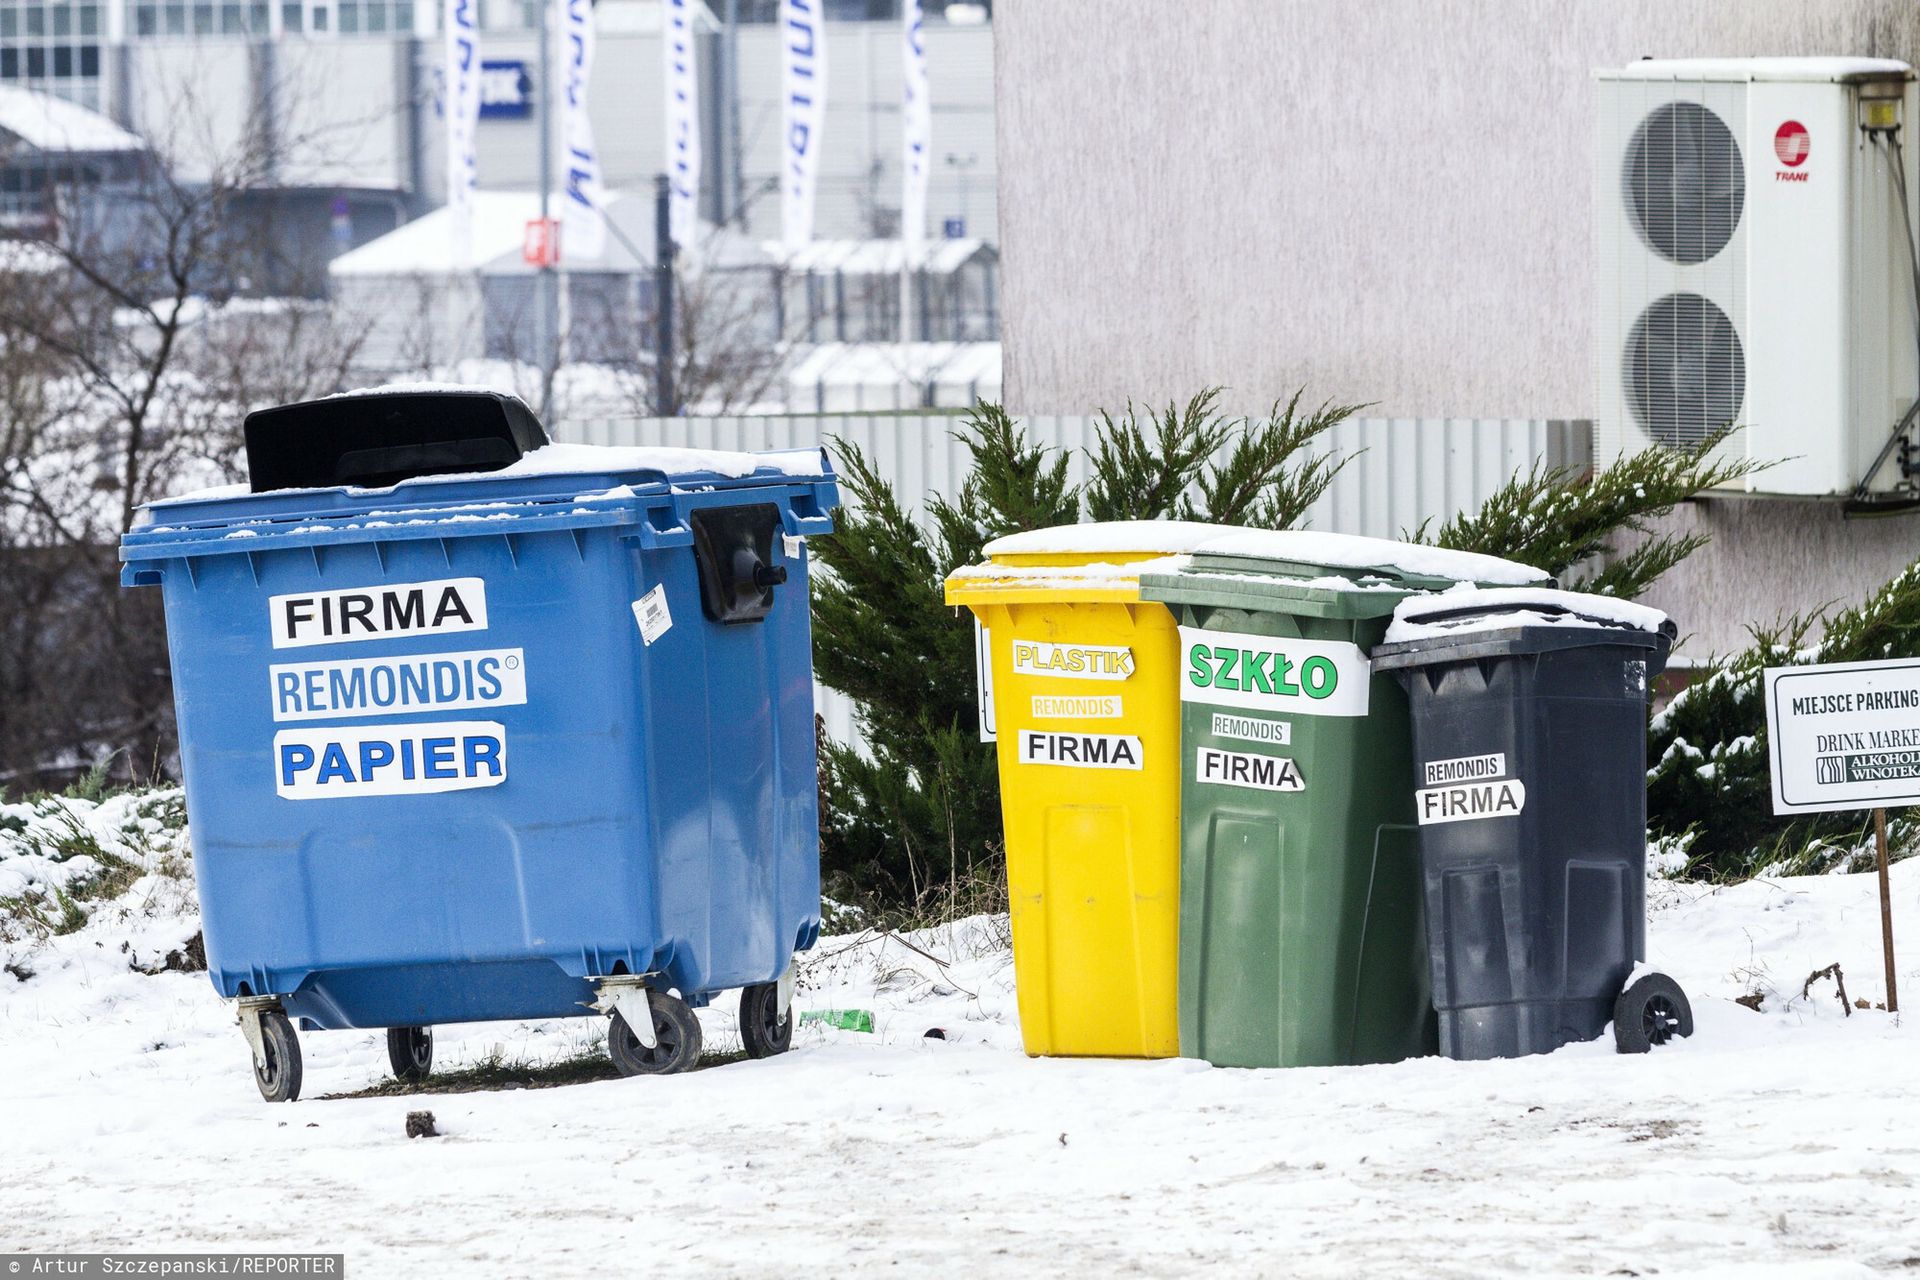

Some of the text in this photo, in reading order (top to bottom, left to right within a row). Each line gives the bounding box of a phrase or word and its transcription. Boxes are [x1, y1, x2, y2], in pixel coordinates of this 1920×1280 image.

[1776, 172, 1809, 181] TRANE
[285, 586, 474, 639] FIRMA
[1016, 645, 1131, 674] PLASTIK
[1189, 643, 1338, 699] SZKŁO
[1034, 698, 1114, 715] REMONDIS
[1792, 689, 1919, 716] MIEJSCE PARKING
[1214, 716, 1283, 741] REMONDIS
[1029, 733, 1136, 765] FIRMA
[1816, 732, 1866, 753] DRINK
[281, 735, 503, 786] PAPIER
[1205, 752, 1298, 788] FIRMA
[1427, 757, 1498, 783] REMONDIS
[1851, 752, 1920, 768] ALKOHOL
[1851, 765, 1920, 780] WINOTEK
[1424, 784, 1518, 819] FIRMA
